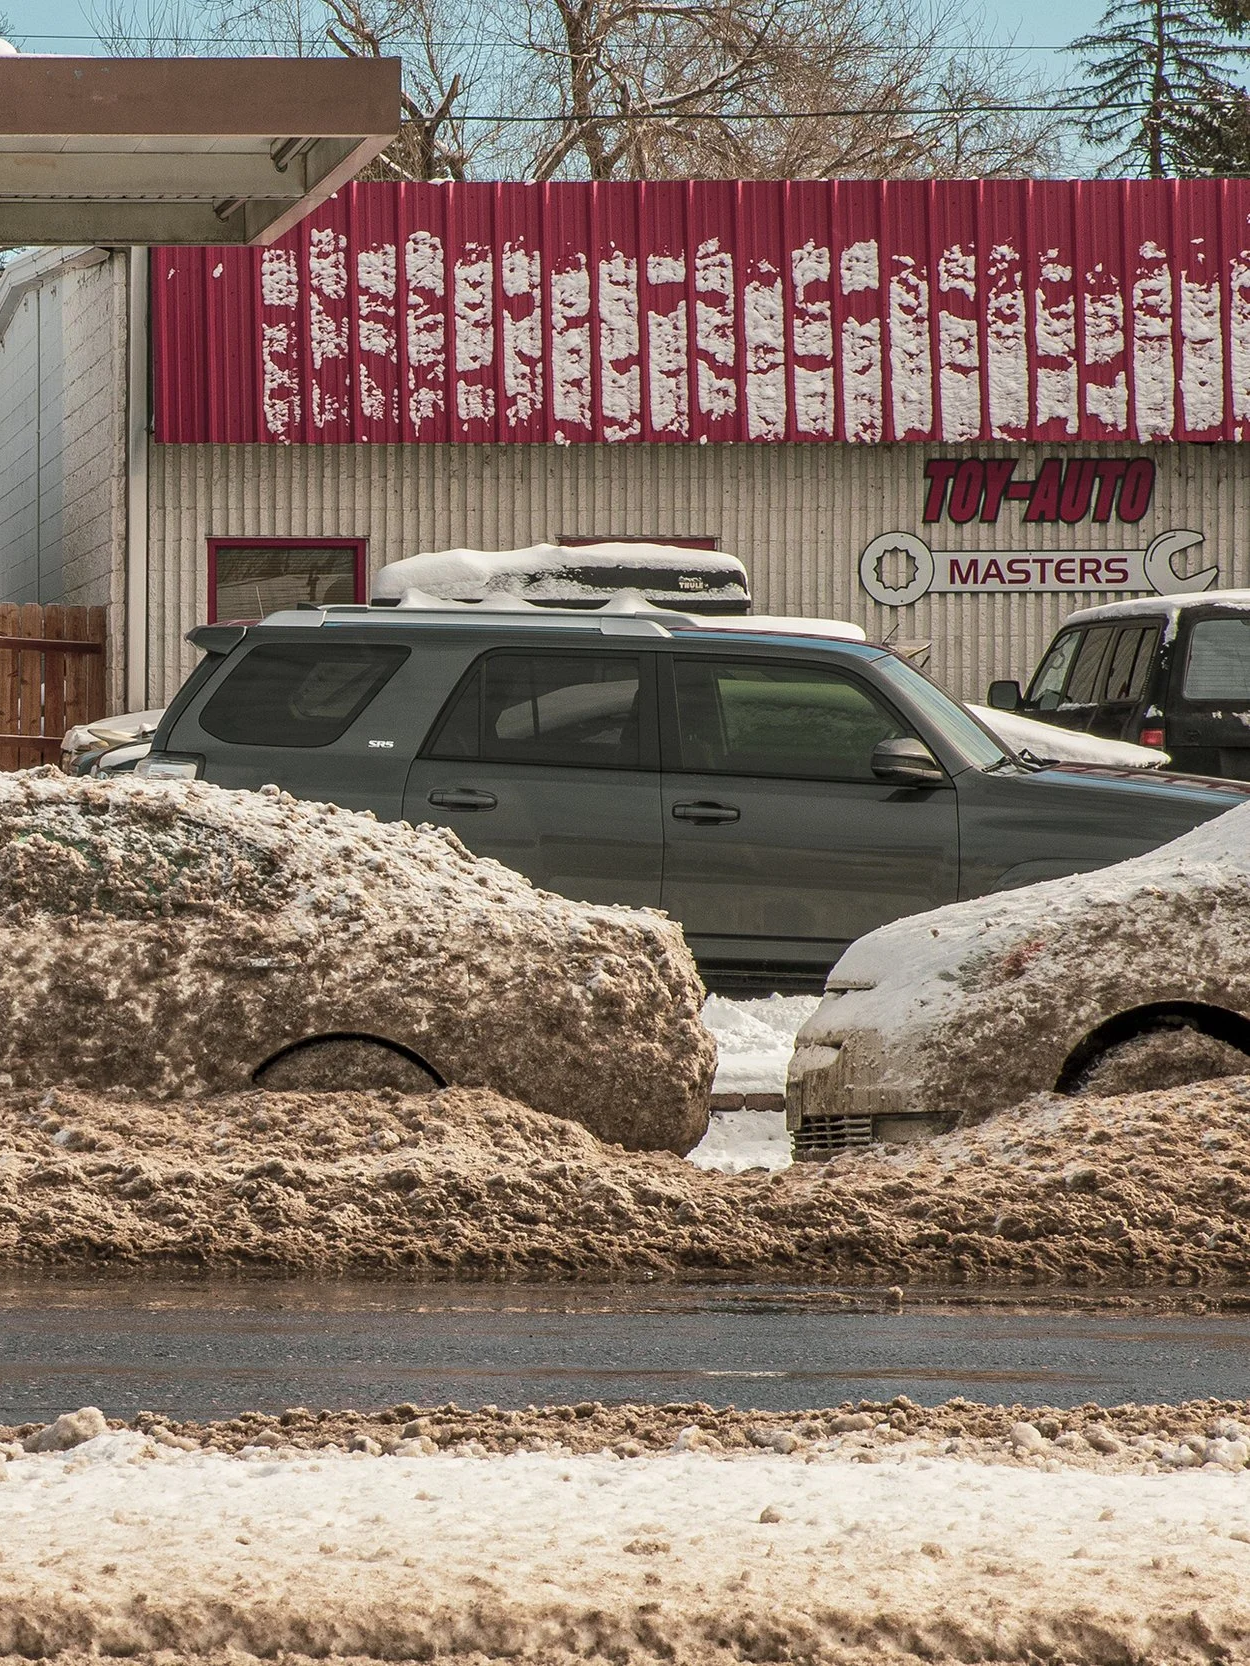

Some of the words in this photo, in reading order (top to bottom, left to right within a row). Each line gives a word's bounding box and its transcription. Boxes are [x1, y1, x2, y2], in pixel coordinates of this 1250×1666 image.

[922, 457, 1156, 524] TOY-AUTO
[949, 557, 1129, 584] MASTERS
[368, 739, 395, 748] SR5
